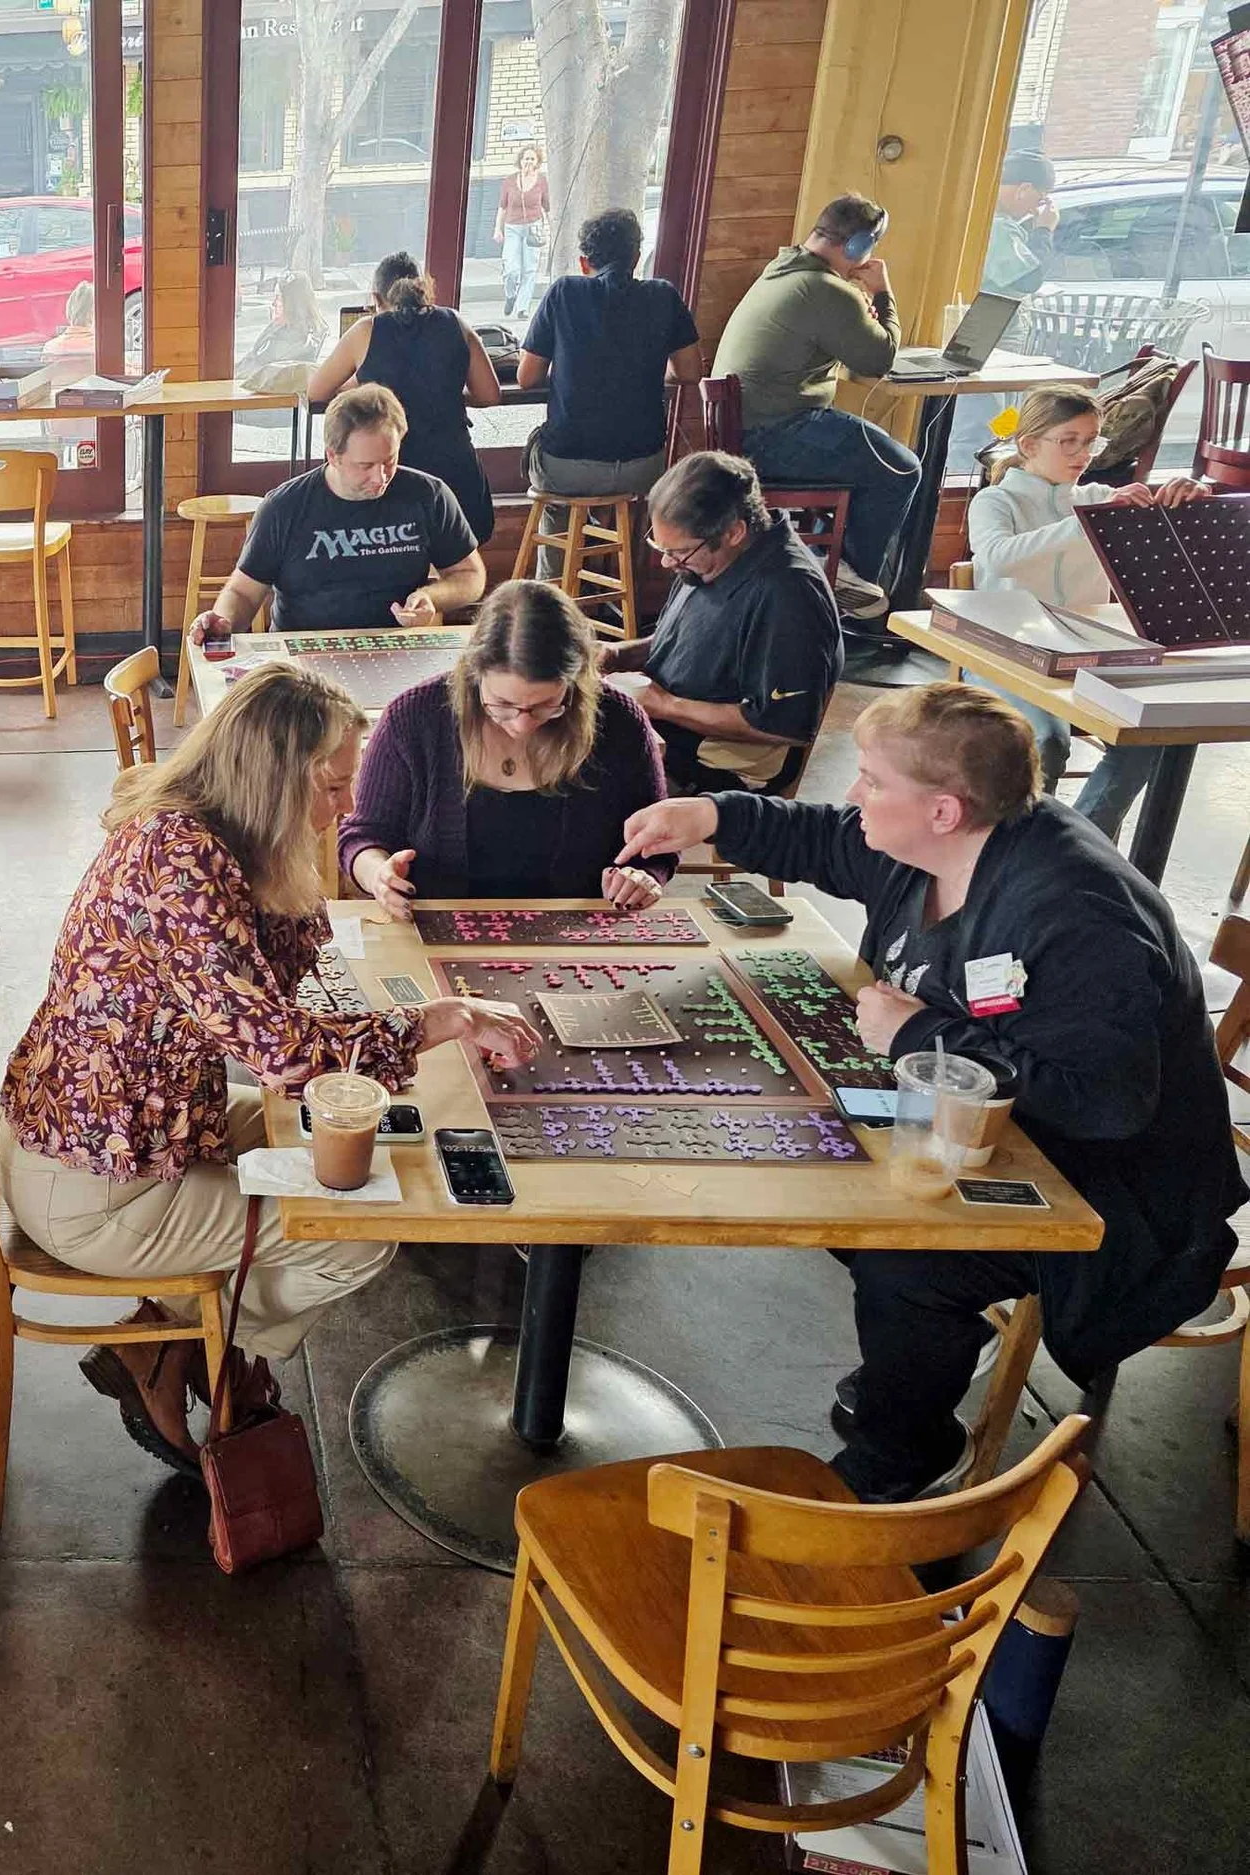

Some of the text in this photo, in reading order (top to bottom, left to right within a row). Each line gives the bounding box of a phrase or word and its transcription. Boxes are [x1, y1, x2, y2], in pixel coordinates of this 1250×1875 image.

[305, 522, 420, 560] MAGIC
[360, 544, 421, 556] The Gathering
